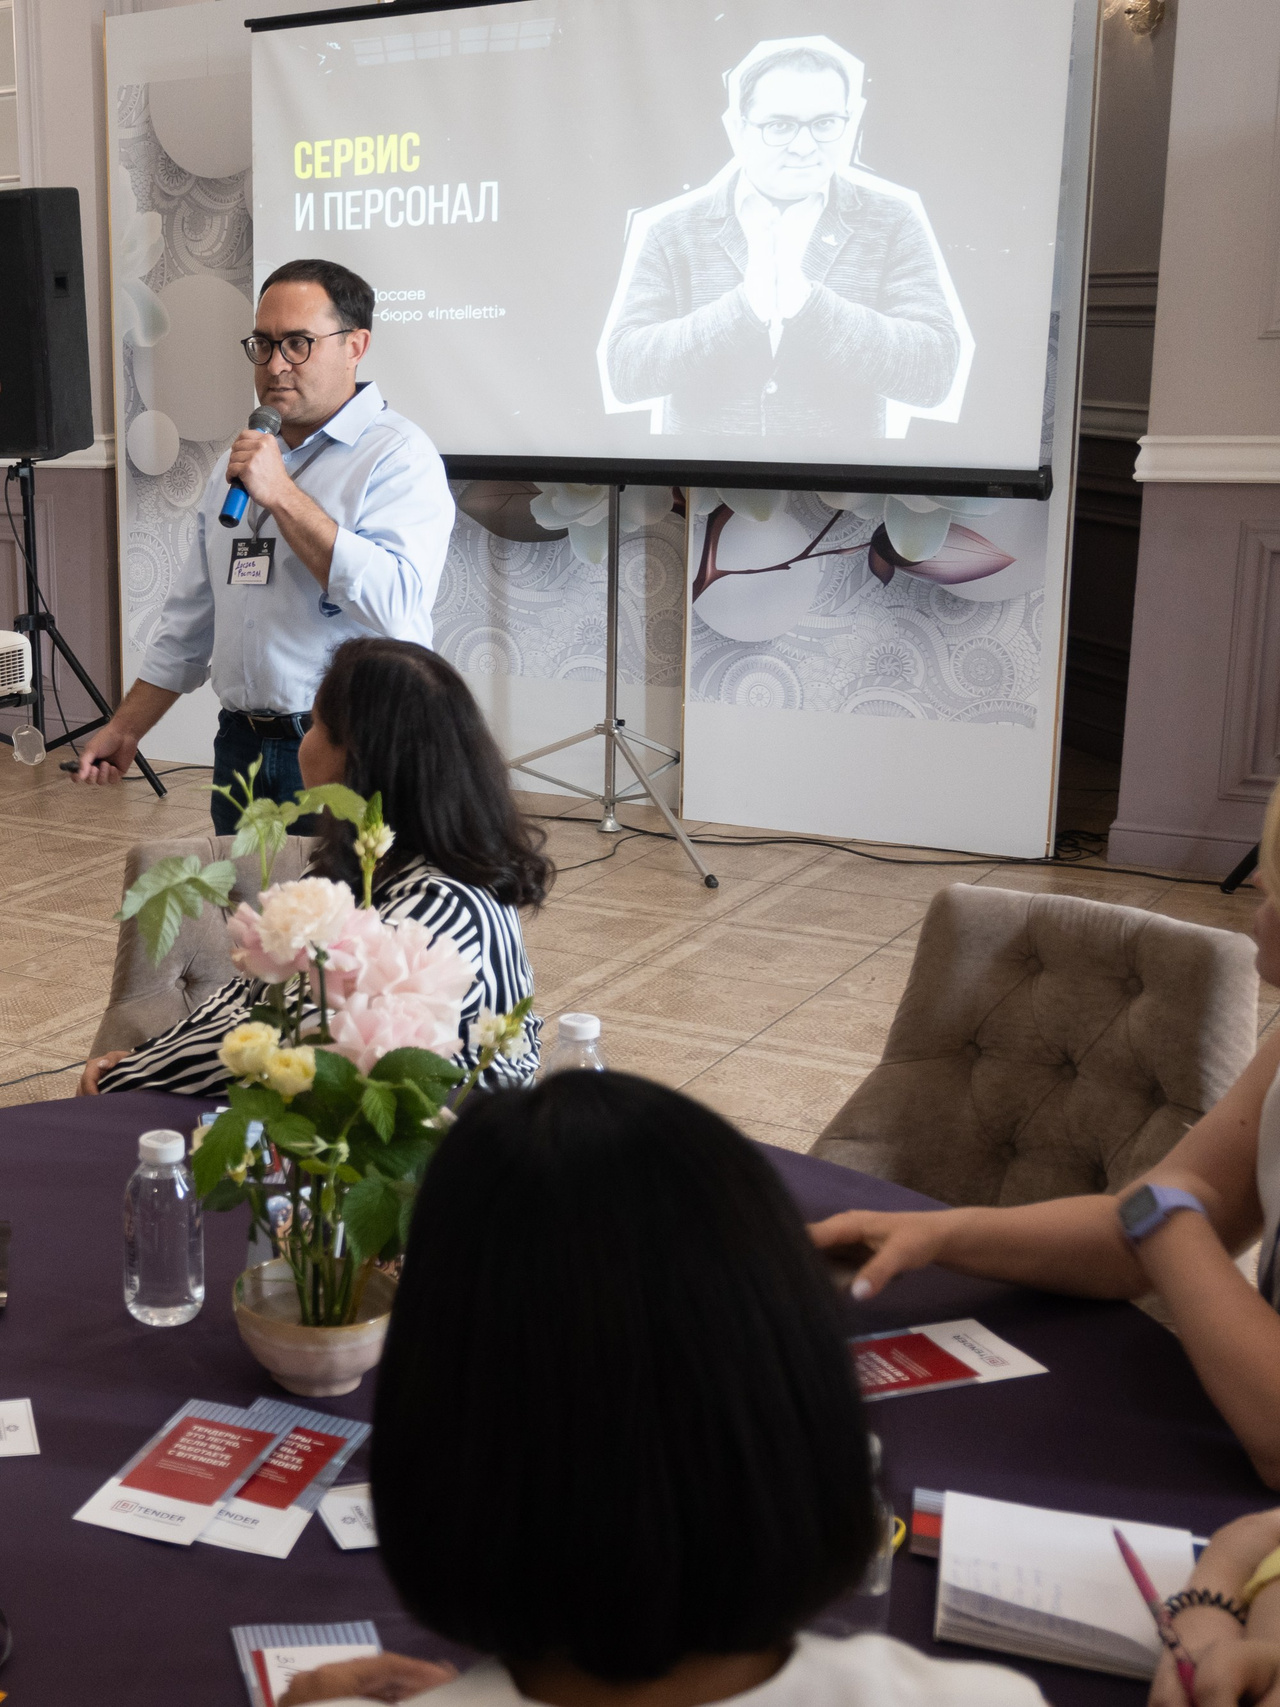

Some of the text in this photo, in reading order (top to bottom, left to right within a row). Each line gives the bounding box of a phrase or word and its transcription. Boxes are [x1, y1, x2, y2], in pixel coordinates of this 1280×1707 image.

[293, 131, 421, 180] СЕРВИС
[294, 180, 499, 232] И ПЕРСОНАЛ
[185, 1431, 206, 1440] ЭТО
[191, 1424, 241, 1441] ТЕНДЕРЫ
[173, 1443, 233, 1461] РАБОТАЕТЕ
[179, 1437, 227, 1453] ЕСЛИ ВЫ
[175, 1451, 231, 1468] BITENDER!
[137, 1505, 187, 1523] TENDER
[219, 1508, 261, 1526] ENDER
